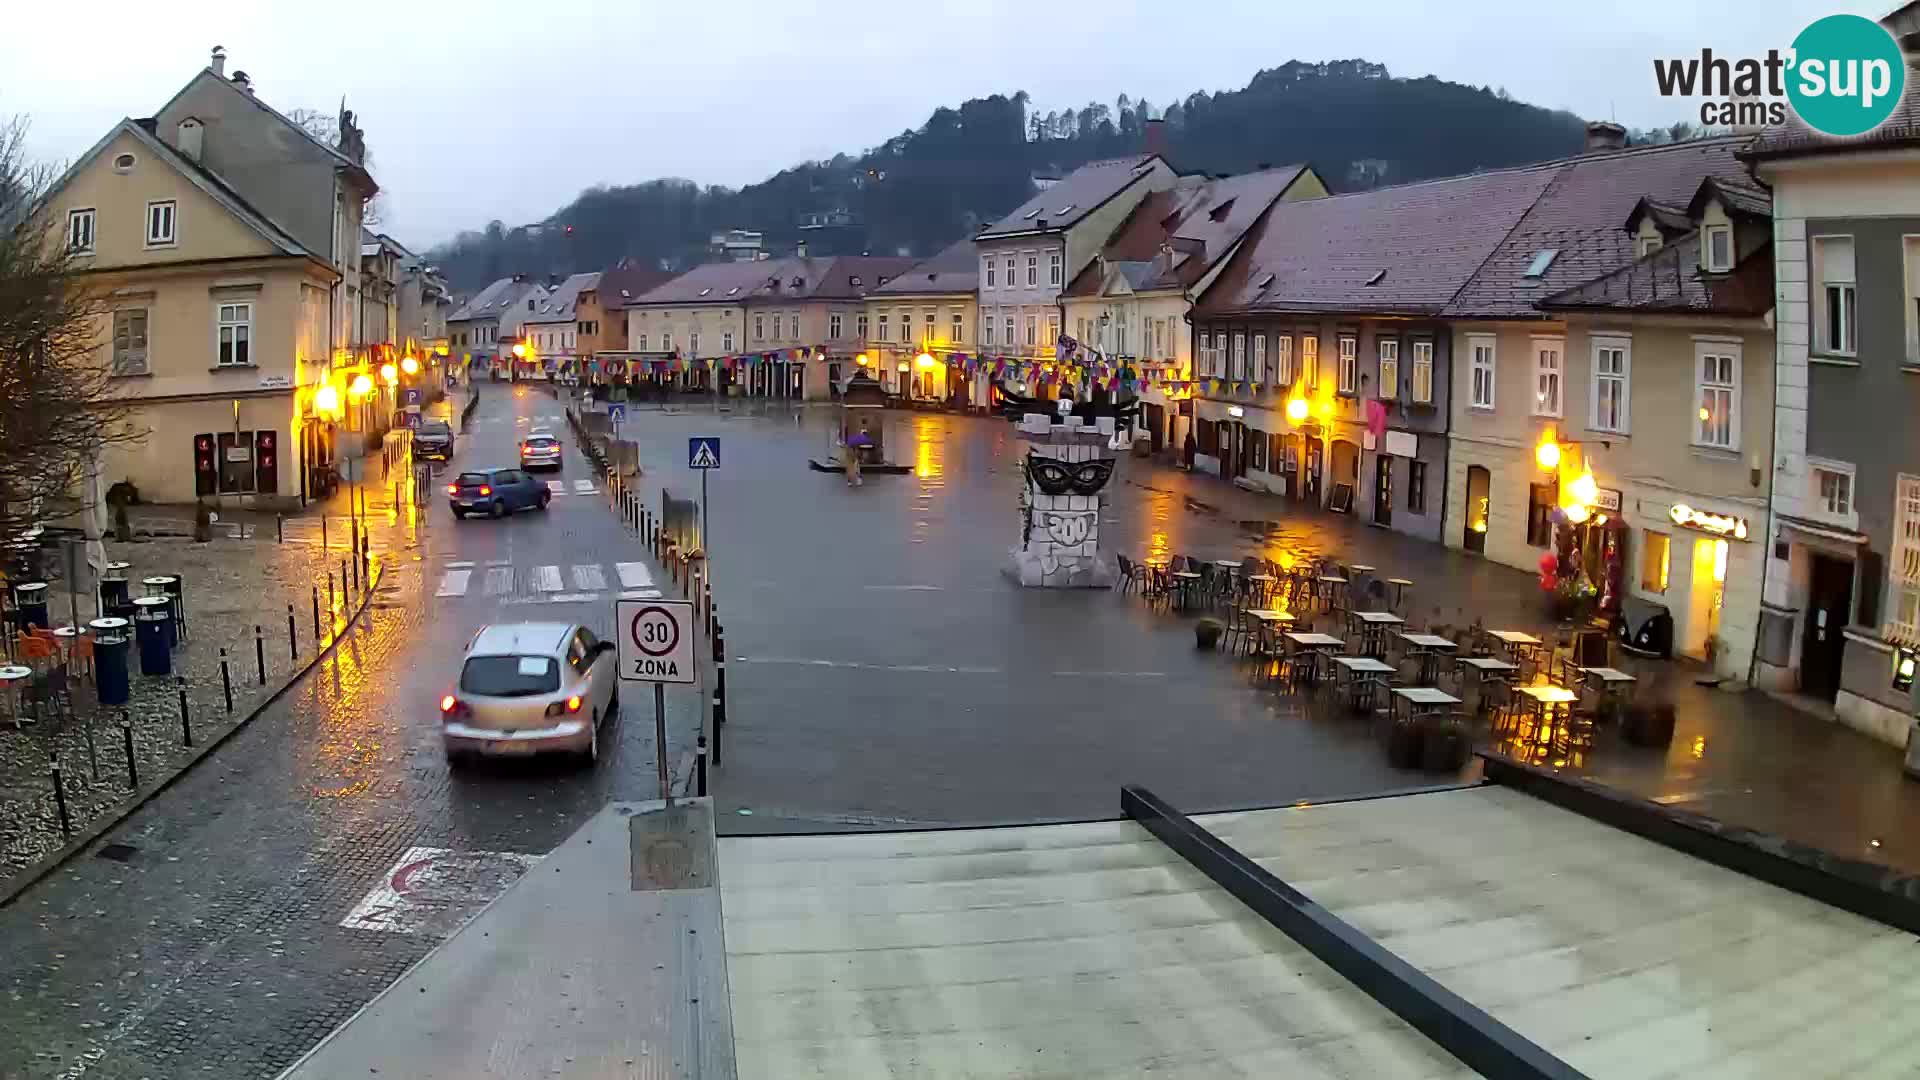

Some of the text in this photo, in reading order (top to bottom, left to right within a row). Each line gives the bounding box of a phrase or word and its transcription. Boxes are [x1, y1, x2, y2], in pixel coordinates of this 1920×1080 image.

[408, 391, 417, 403] P
[643, 622, 668, 643] 30
[634, 659, 678, 677] ZONA
